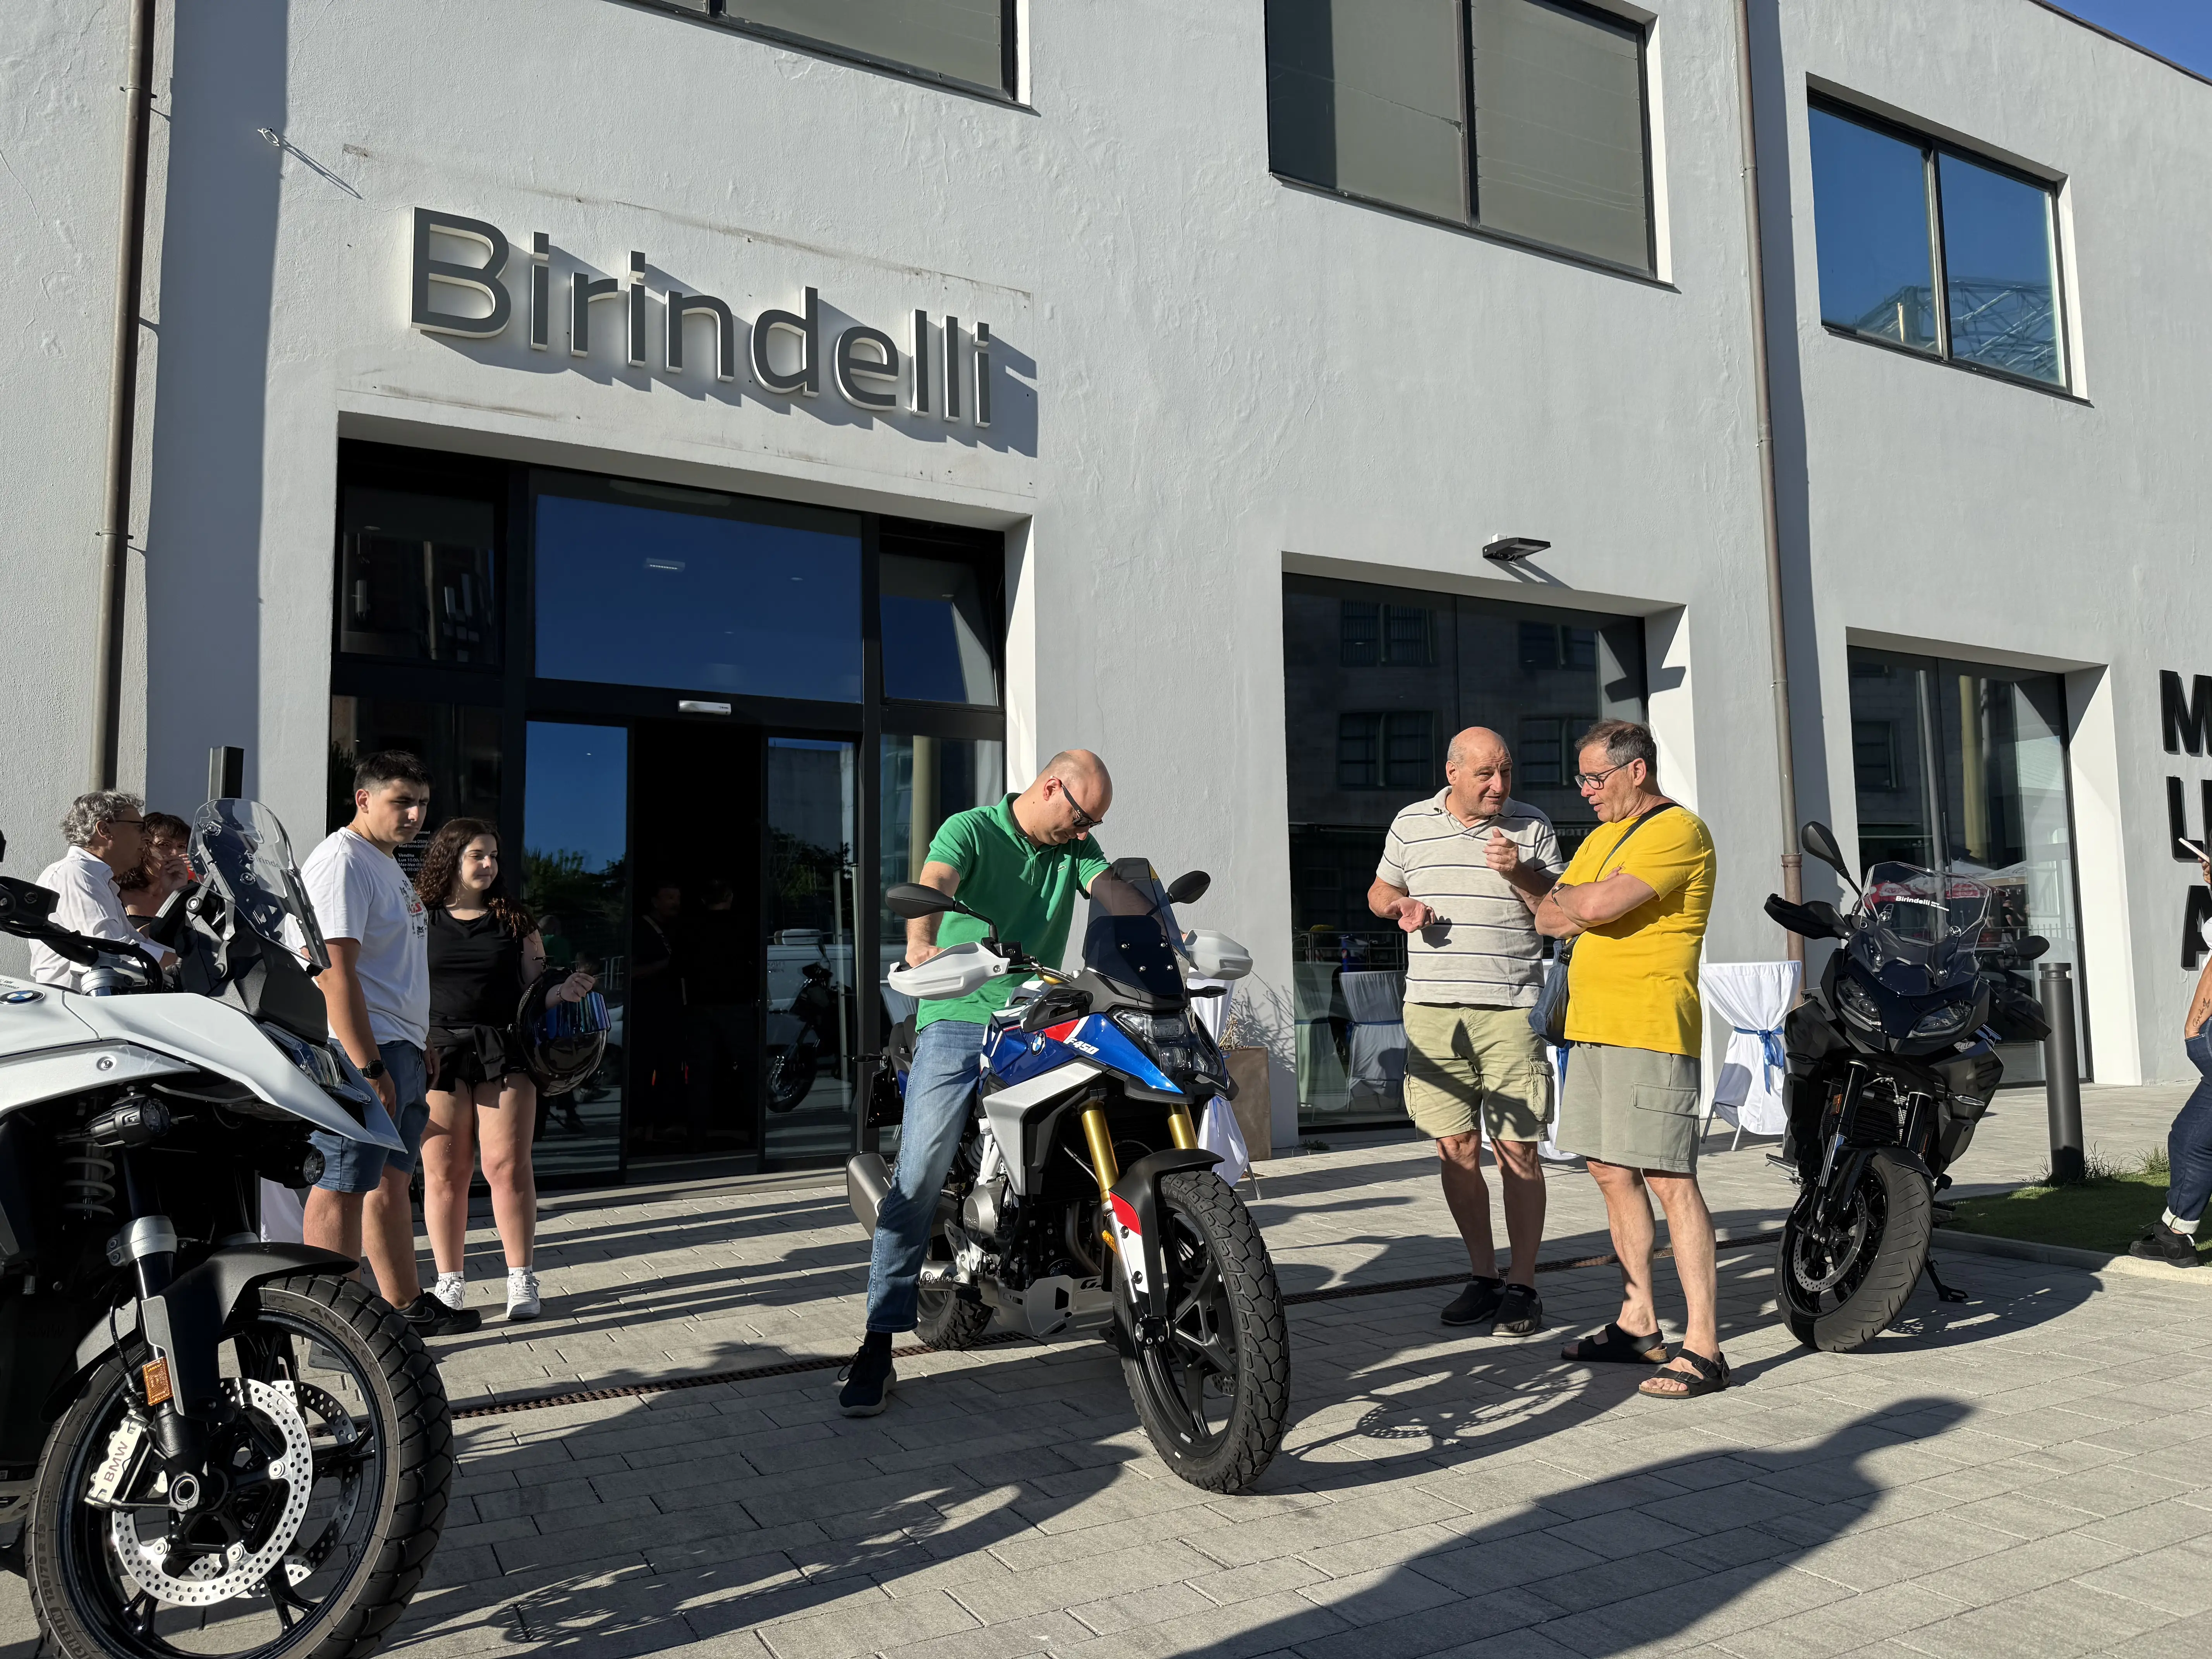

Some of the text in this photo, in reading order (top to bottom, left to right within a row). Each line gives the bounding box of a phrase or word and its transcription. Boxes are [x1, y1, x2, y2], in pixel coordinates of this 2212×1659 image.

[410, 207, 991, 427] Birindelli
[247, 852, 282, 870] Birinde
[1895, 896, 1930, 906] Birindelli
[1066, 1037, 1099, 1055] F450
[1793, 1195, 1808, 1214] brembo
[310, 1307, 378, 1377] ANAKEE
[104, 1441, 128, 1482] BMW
[38, 1523, 46, 1542] 19
[38, 1543, 46, 1552] R
[39, 1556, 55, 1602] 120/70
[52, 1609, 91, 1659] ICHELIN
